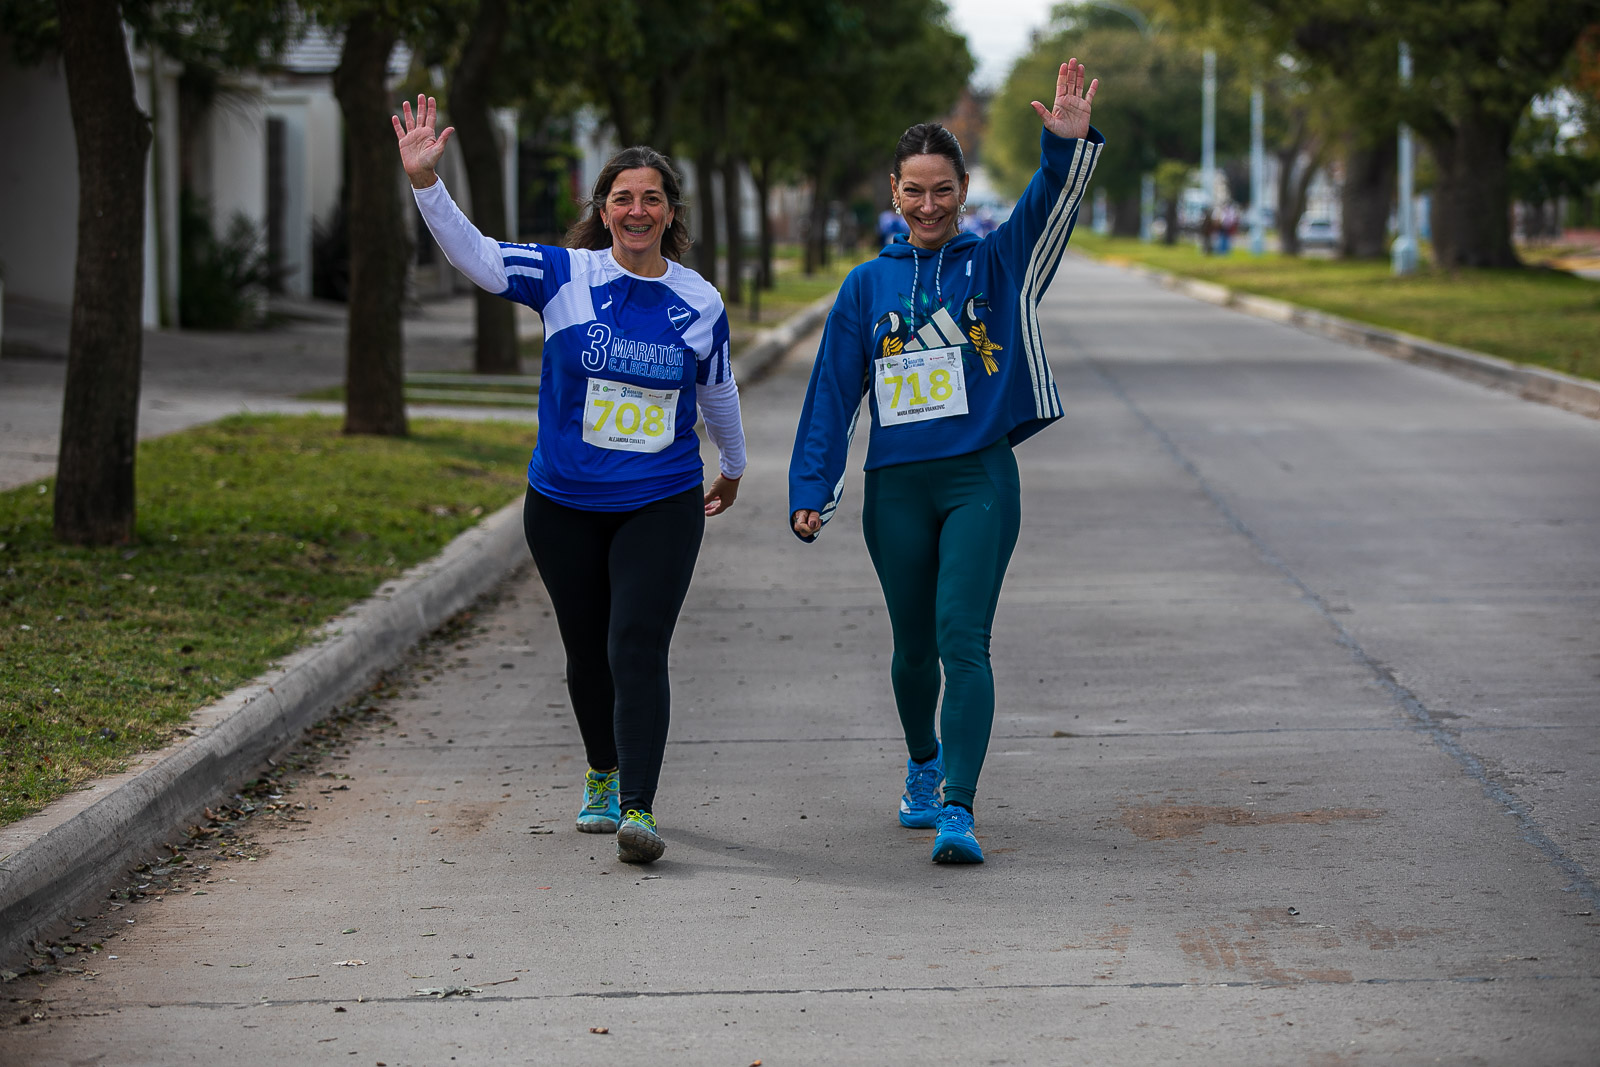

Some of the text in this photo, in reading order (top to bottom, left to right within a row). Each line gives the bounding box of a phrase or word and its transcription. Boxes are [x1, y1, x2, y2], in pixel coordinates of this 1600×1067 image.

[581, 323, 684, 372] 3 MARATÓN
[884, 368, 954, 409] 718
[592, 399, 665, 437] 708
